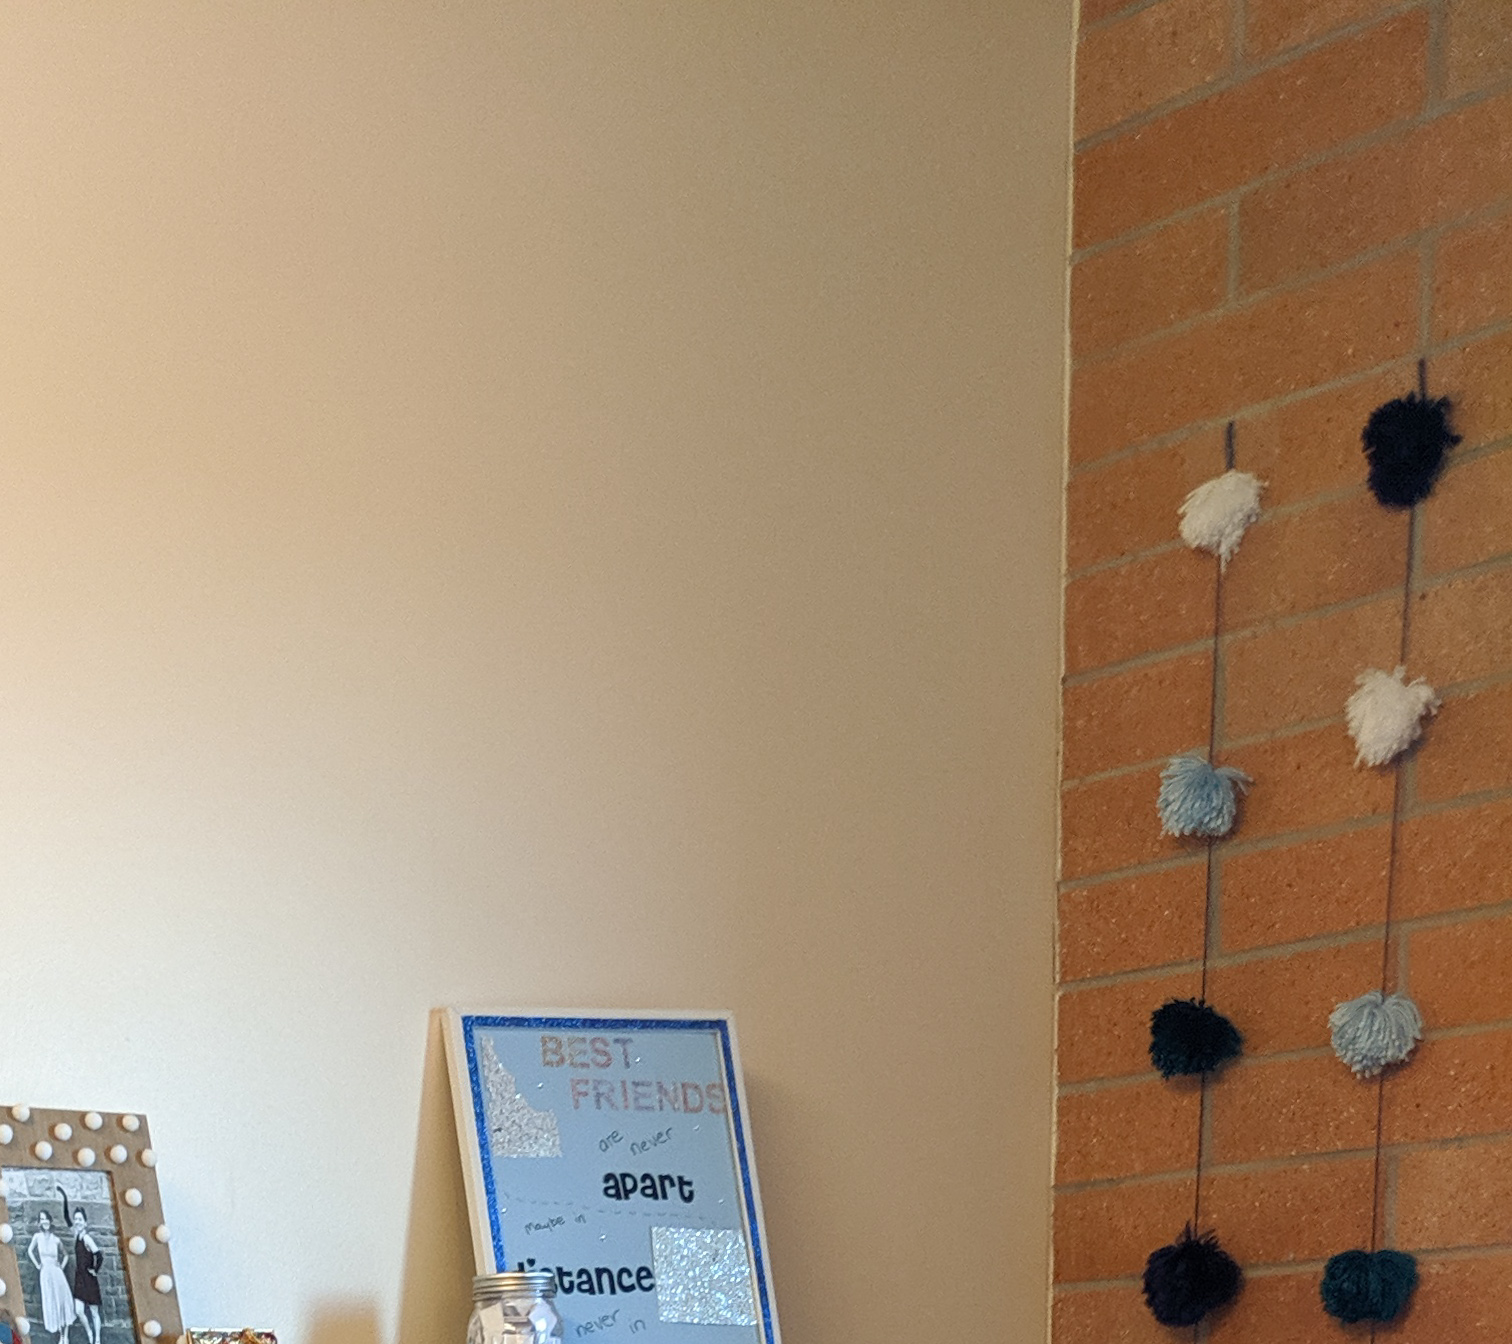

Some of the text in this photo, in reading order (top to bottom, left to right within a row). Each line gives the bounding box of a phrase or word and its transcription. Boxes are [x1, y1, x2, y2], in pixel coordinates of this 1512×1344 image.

[540, 1035, 634, 1069] BEST
[570, 1078, 727, 1114] FRIENDS
[598, 1126, 673, 1157] are never
[602, 1172, 695, 1204] apart
[575, 1308, 647, 1338] never in
